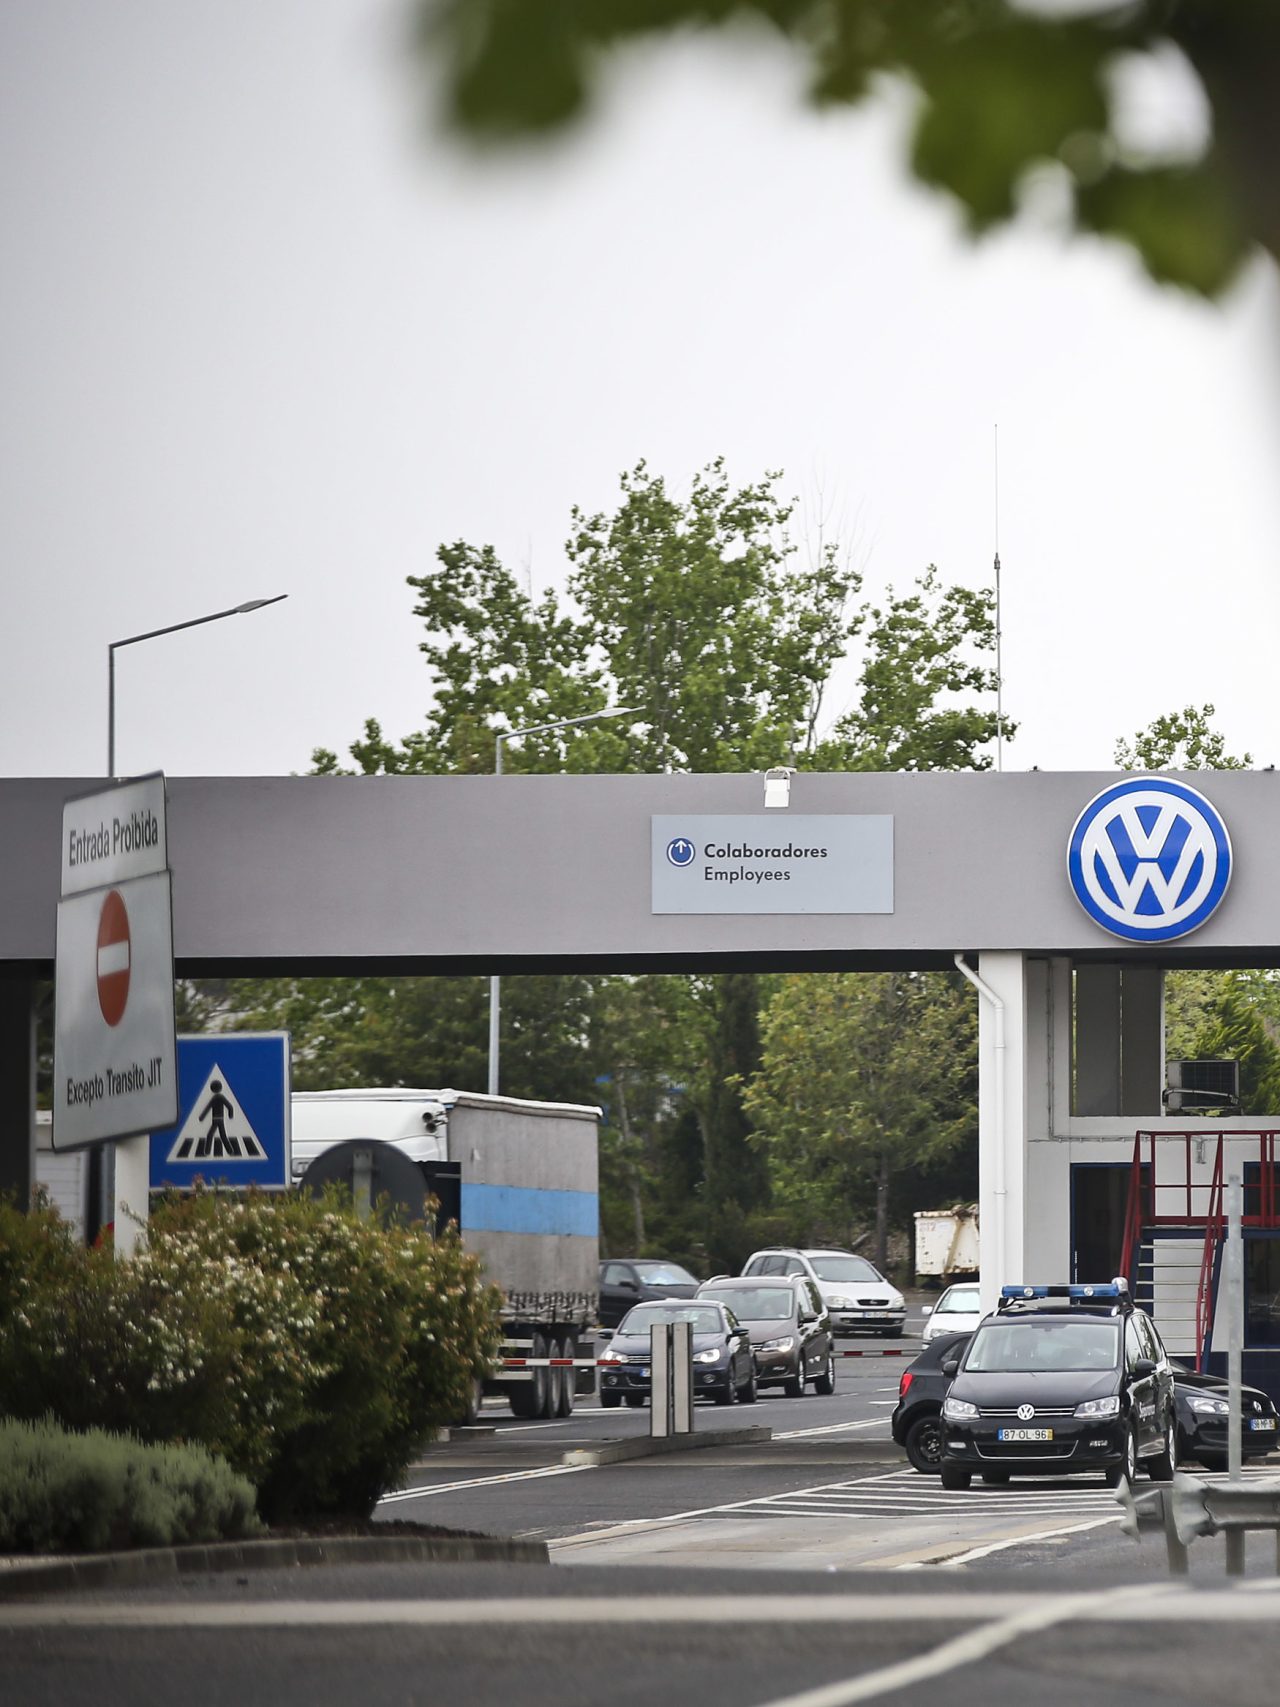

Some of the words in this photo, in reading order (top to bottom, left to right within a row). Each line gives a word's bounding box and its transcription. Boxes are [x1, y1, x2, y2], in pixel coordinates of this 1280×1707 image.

[69, 820, 110, 867] Entrada
[112, 808, 159, 856] Proibida
[704, 843, 828, 858] Colaboradores
[1081, 789, 1218, 930] VW
[704, 865, 791, 884] Employees
[66, 1072, 104, 1108] Excepto
[106, 1063, 145, 1097] Transito
[147, 1057, 163, 1088] JIT
